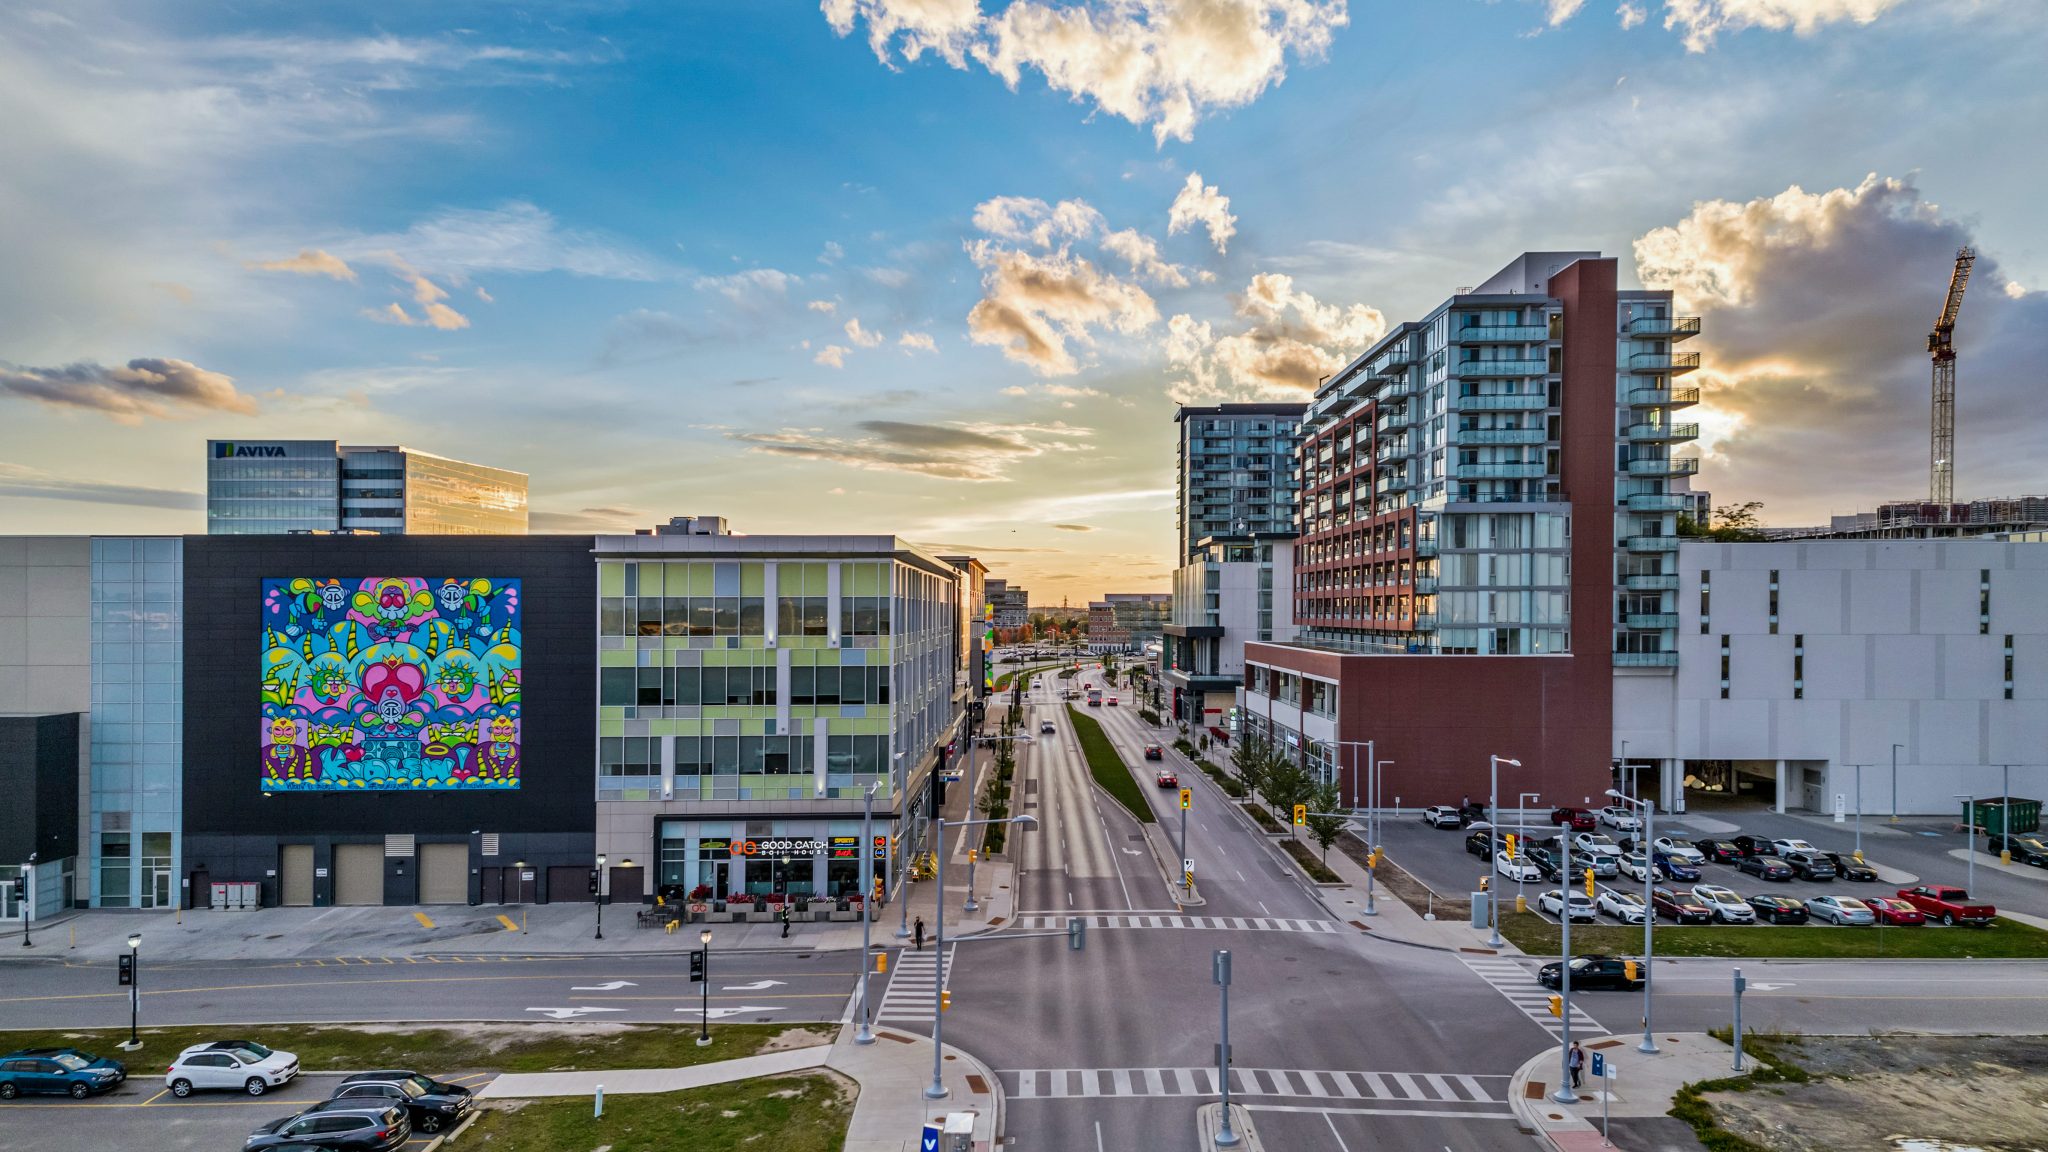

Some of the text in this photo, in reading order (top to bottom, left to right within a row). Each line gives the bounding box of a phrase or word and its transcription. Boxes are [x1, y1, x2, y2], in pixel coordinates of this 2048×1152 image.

[236, 446, 286, 457] AVIVA
[761, 841, 829, 849] GOOD CATCH
